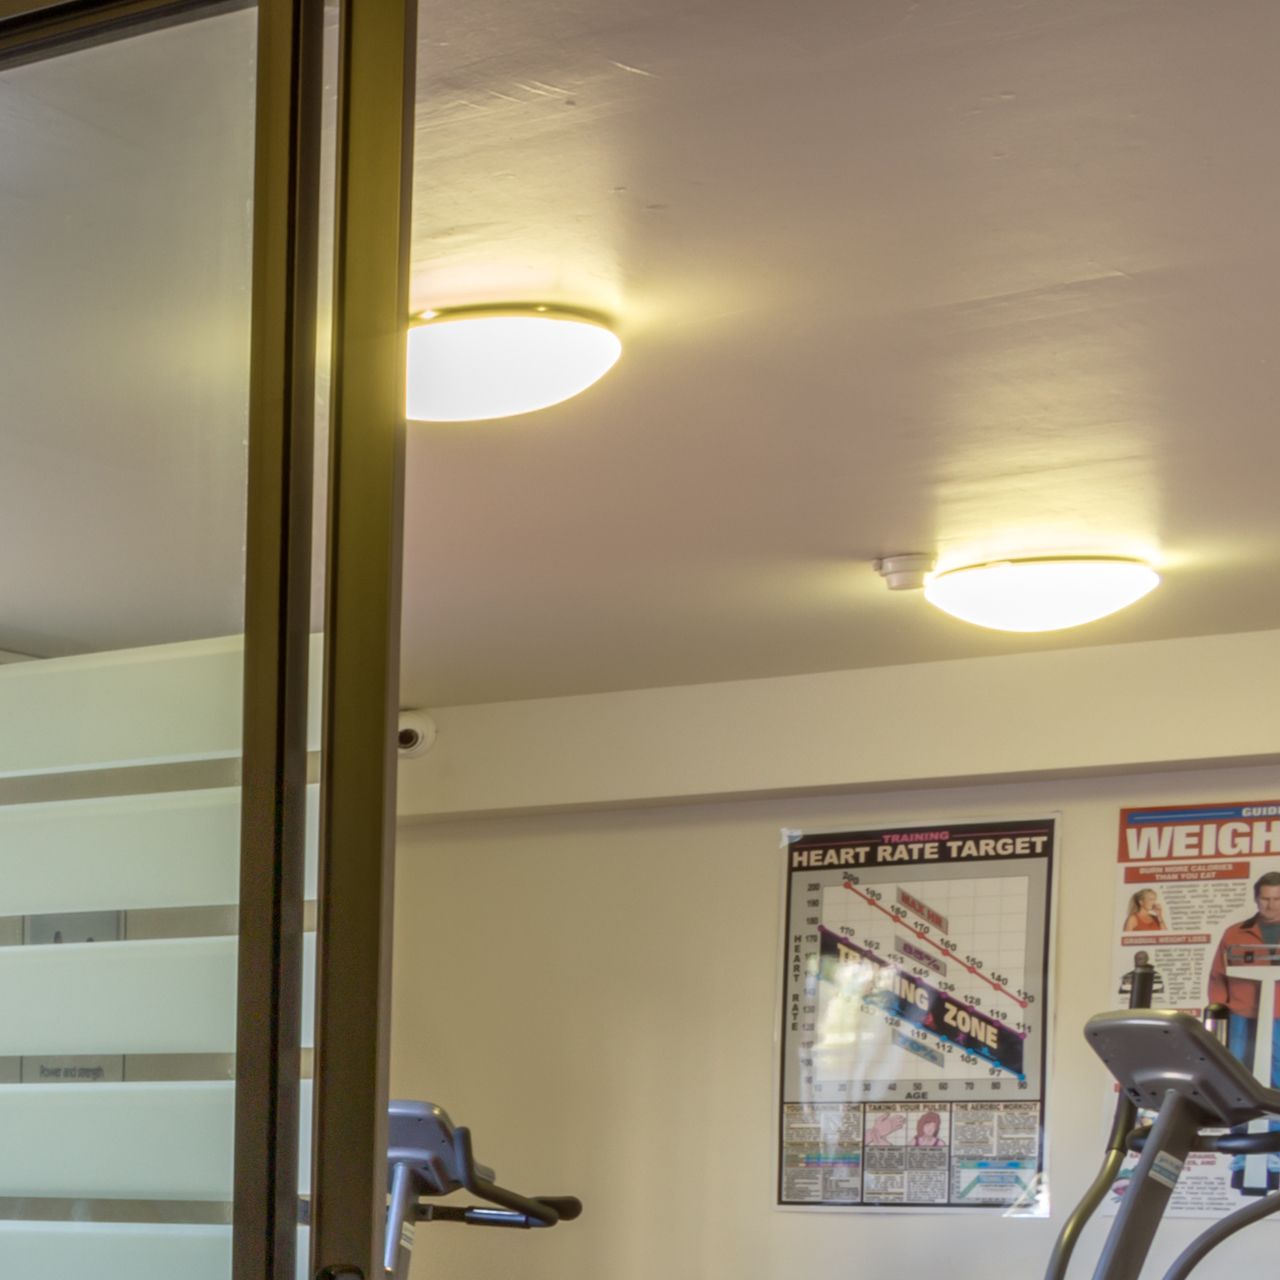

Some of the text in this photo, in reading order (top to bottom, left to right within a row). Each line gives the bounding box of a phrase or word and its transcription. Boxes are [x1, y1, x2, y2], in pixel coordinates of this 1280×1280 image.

[1242, 804, 1280, 817] GUID
[881, 831, 950, 844] TRAINING
[792, 835, 1048, 868] HEART RATE TARGET
[943, 1001, 999, 1050] ZONE
[905, 1091, 928, 1100] AGE
